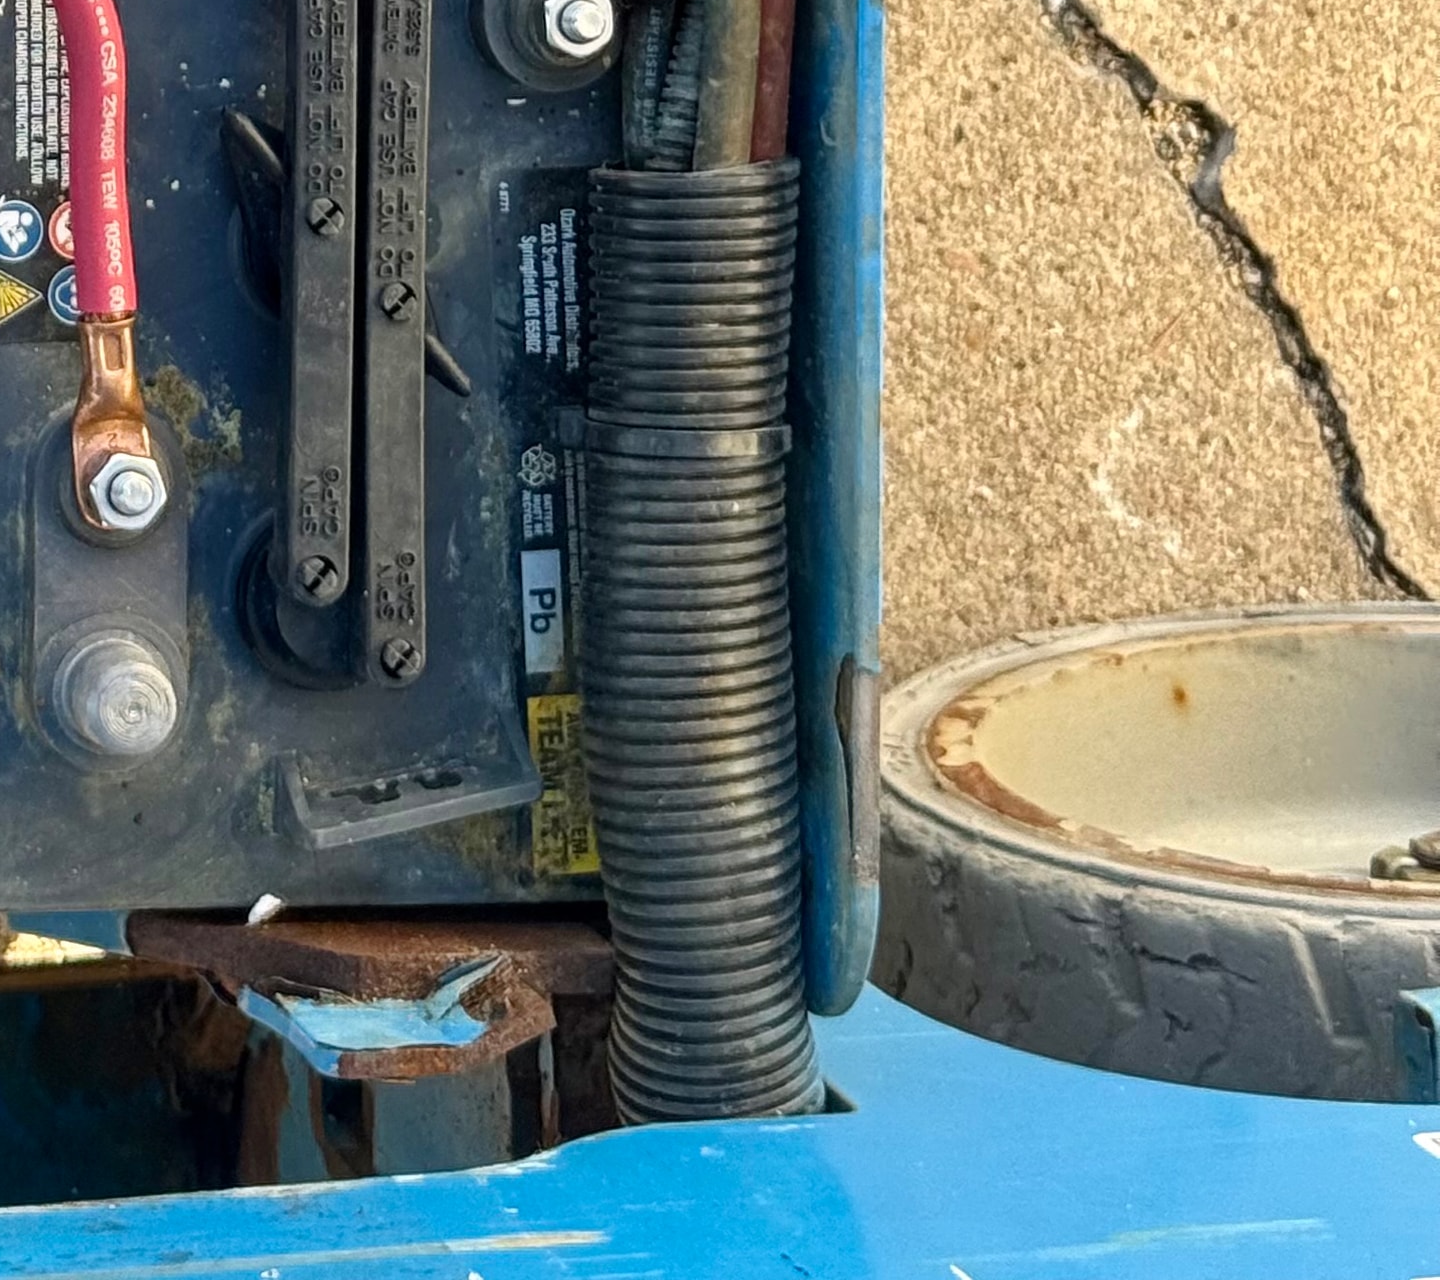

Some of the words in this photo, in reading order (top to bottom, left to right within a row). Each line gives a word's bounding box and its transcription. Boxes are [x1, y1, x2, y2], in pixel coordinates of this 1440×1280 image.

[100, 40, 118, 86] CSA
[307, 50, 325, 96] USE
[100, 93, 118, 161] 234608
[307, 103, 325, 153] NOT
[329, 104, 346, 156] LIFT
[101, 167, 120, 209] TEW
[306, 162, 325, 196] DO
[329, 164, 346, 197] TO
[301, 472, 320, 537] SPIN
[528, 586, 556, 634] Pb
